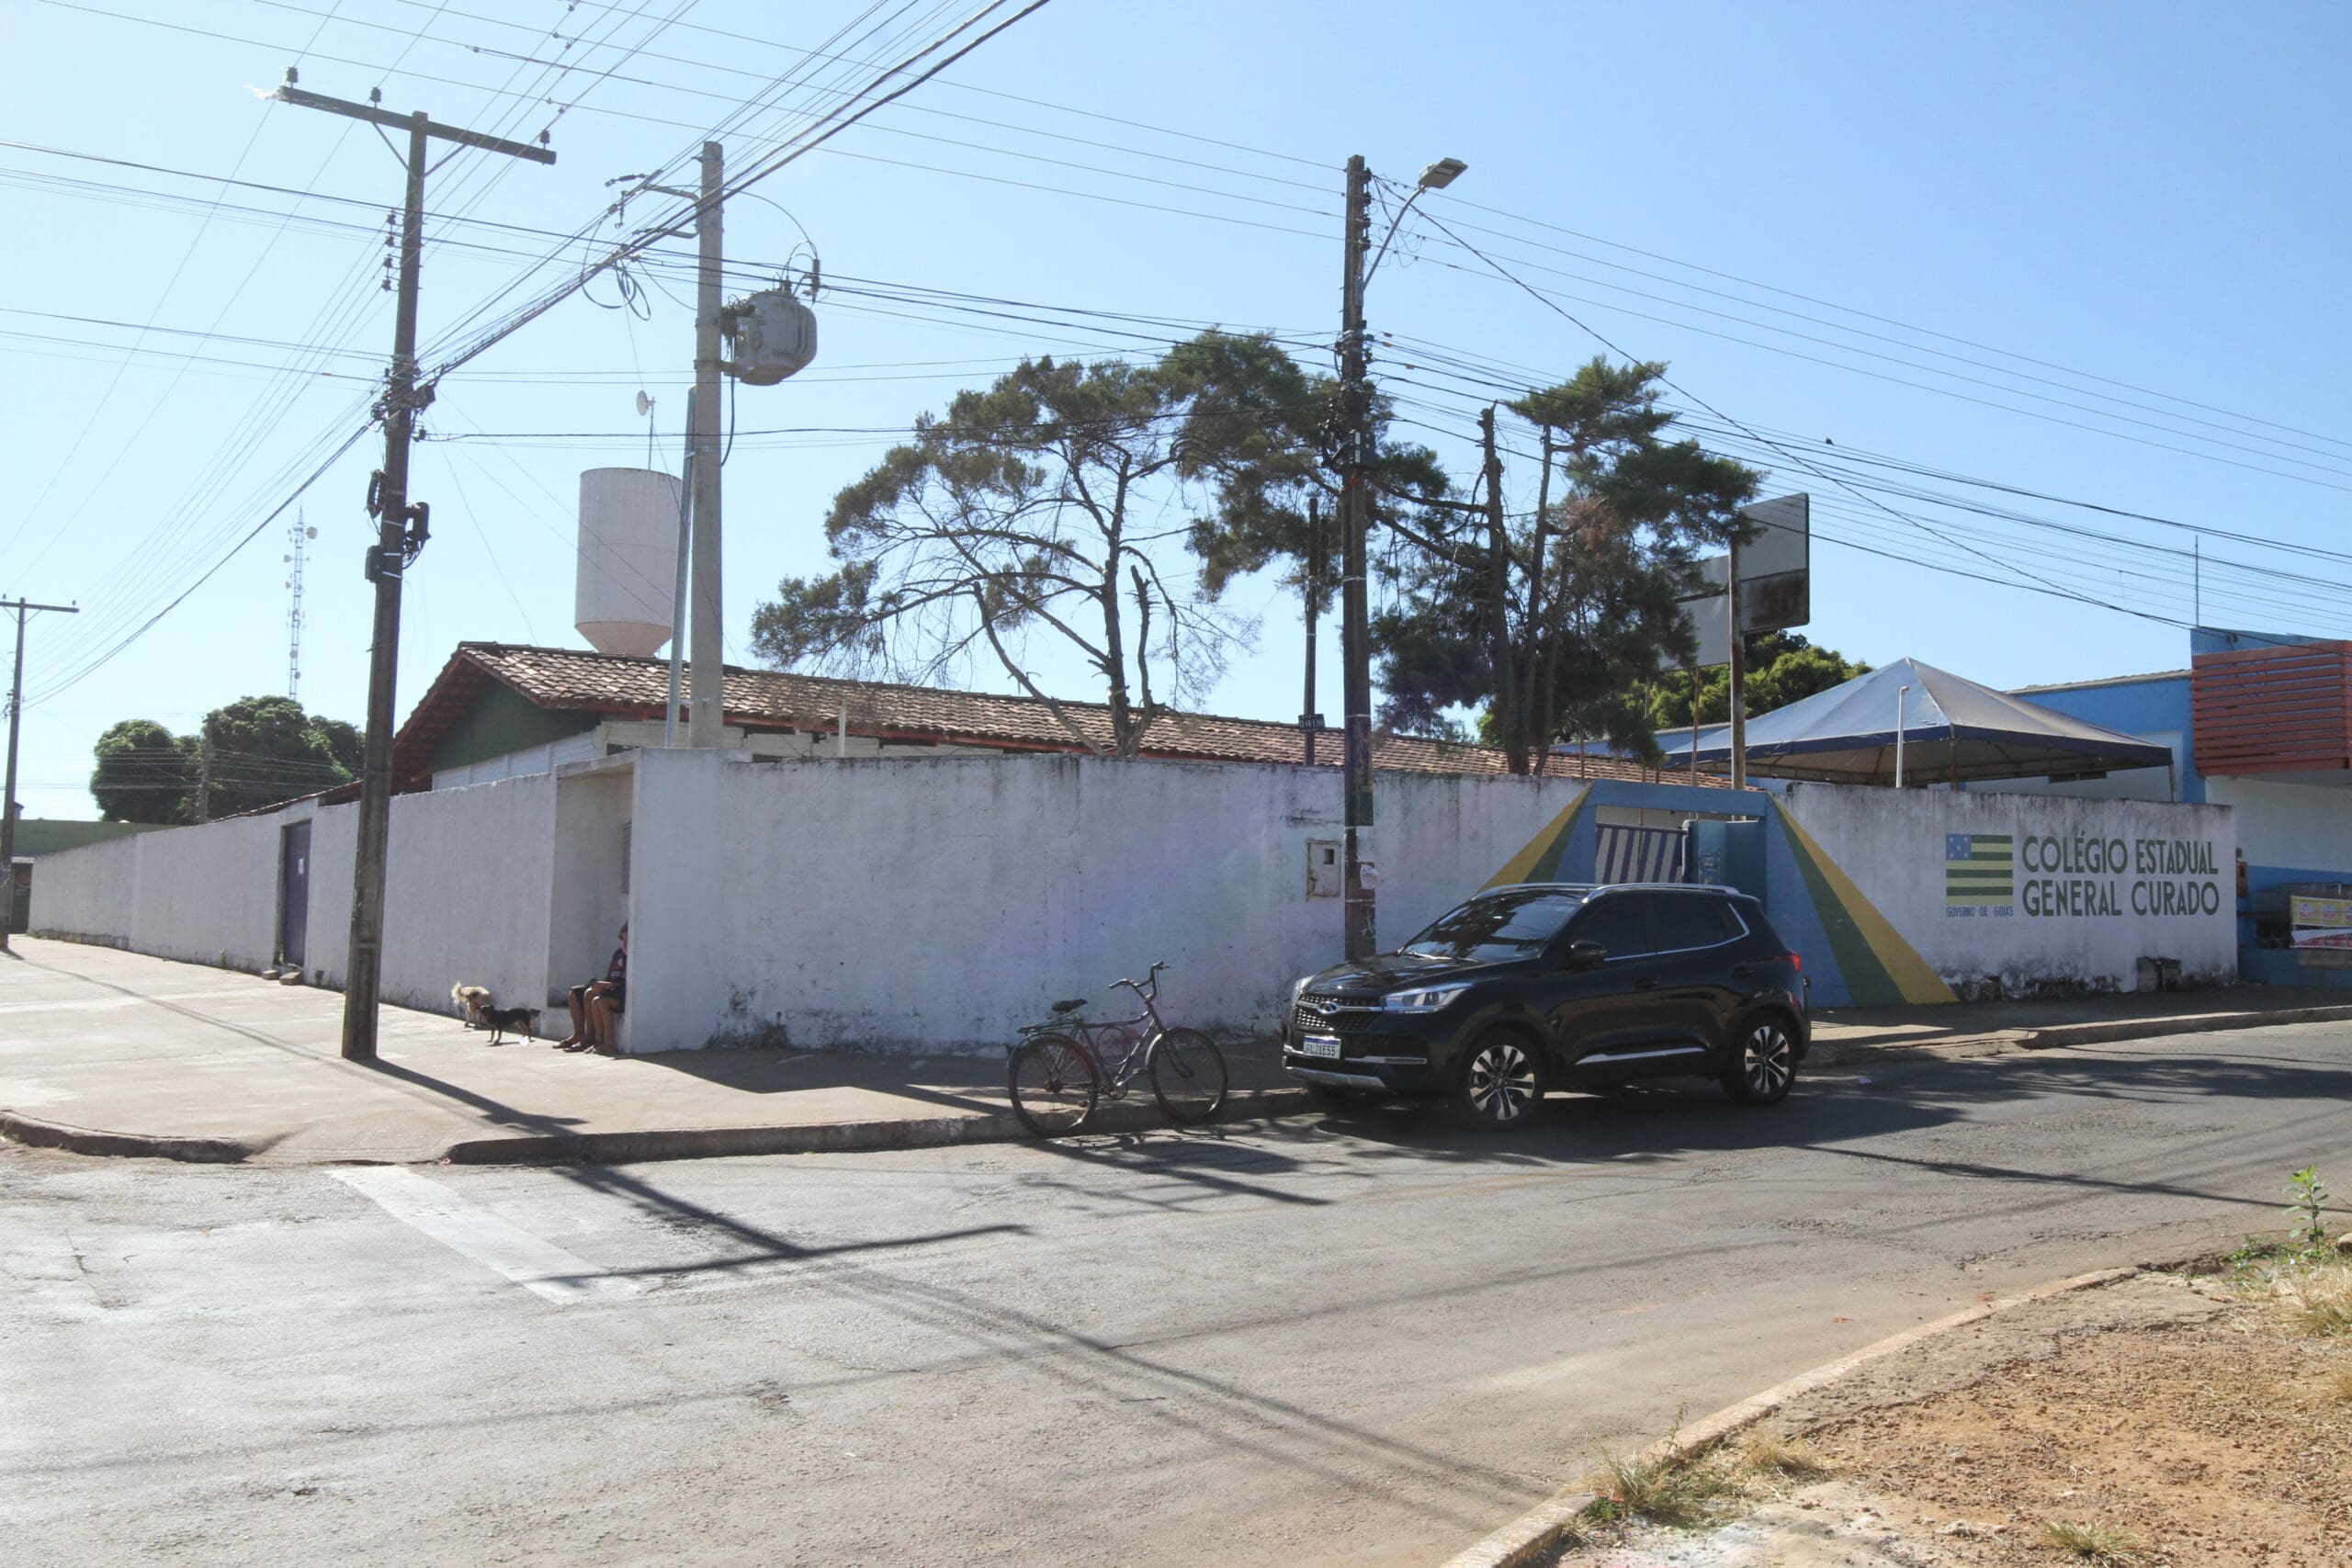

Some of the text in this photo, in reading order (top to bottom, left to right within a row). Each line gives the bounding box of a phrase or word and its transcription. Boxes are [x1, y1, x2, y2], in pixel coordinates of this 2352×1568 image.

[2022, 830, 2219, 874] COLÉGIO ESTADUAL
[1946, 906, 1974, 918] GOVERNO
[1980, 906, 1988, 918] DE
[2022, 880, 2220, 917] GENERAL CURADO
